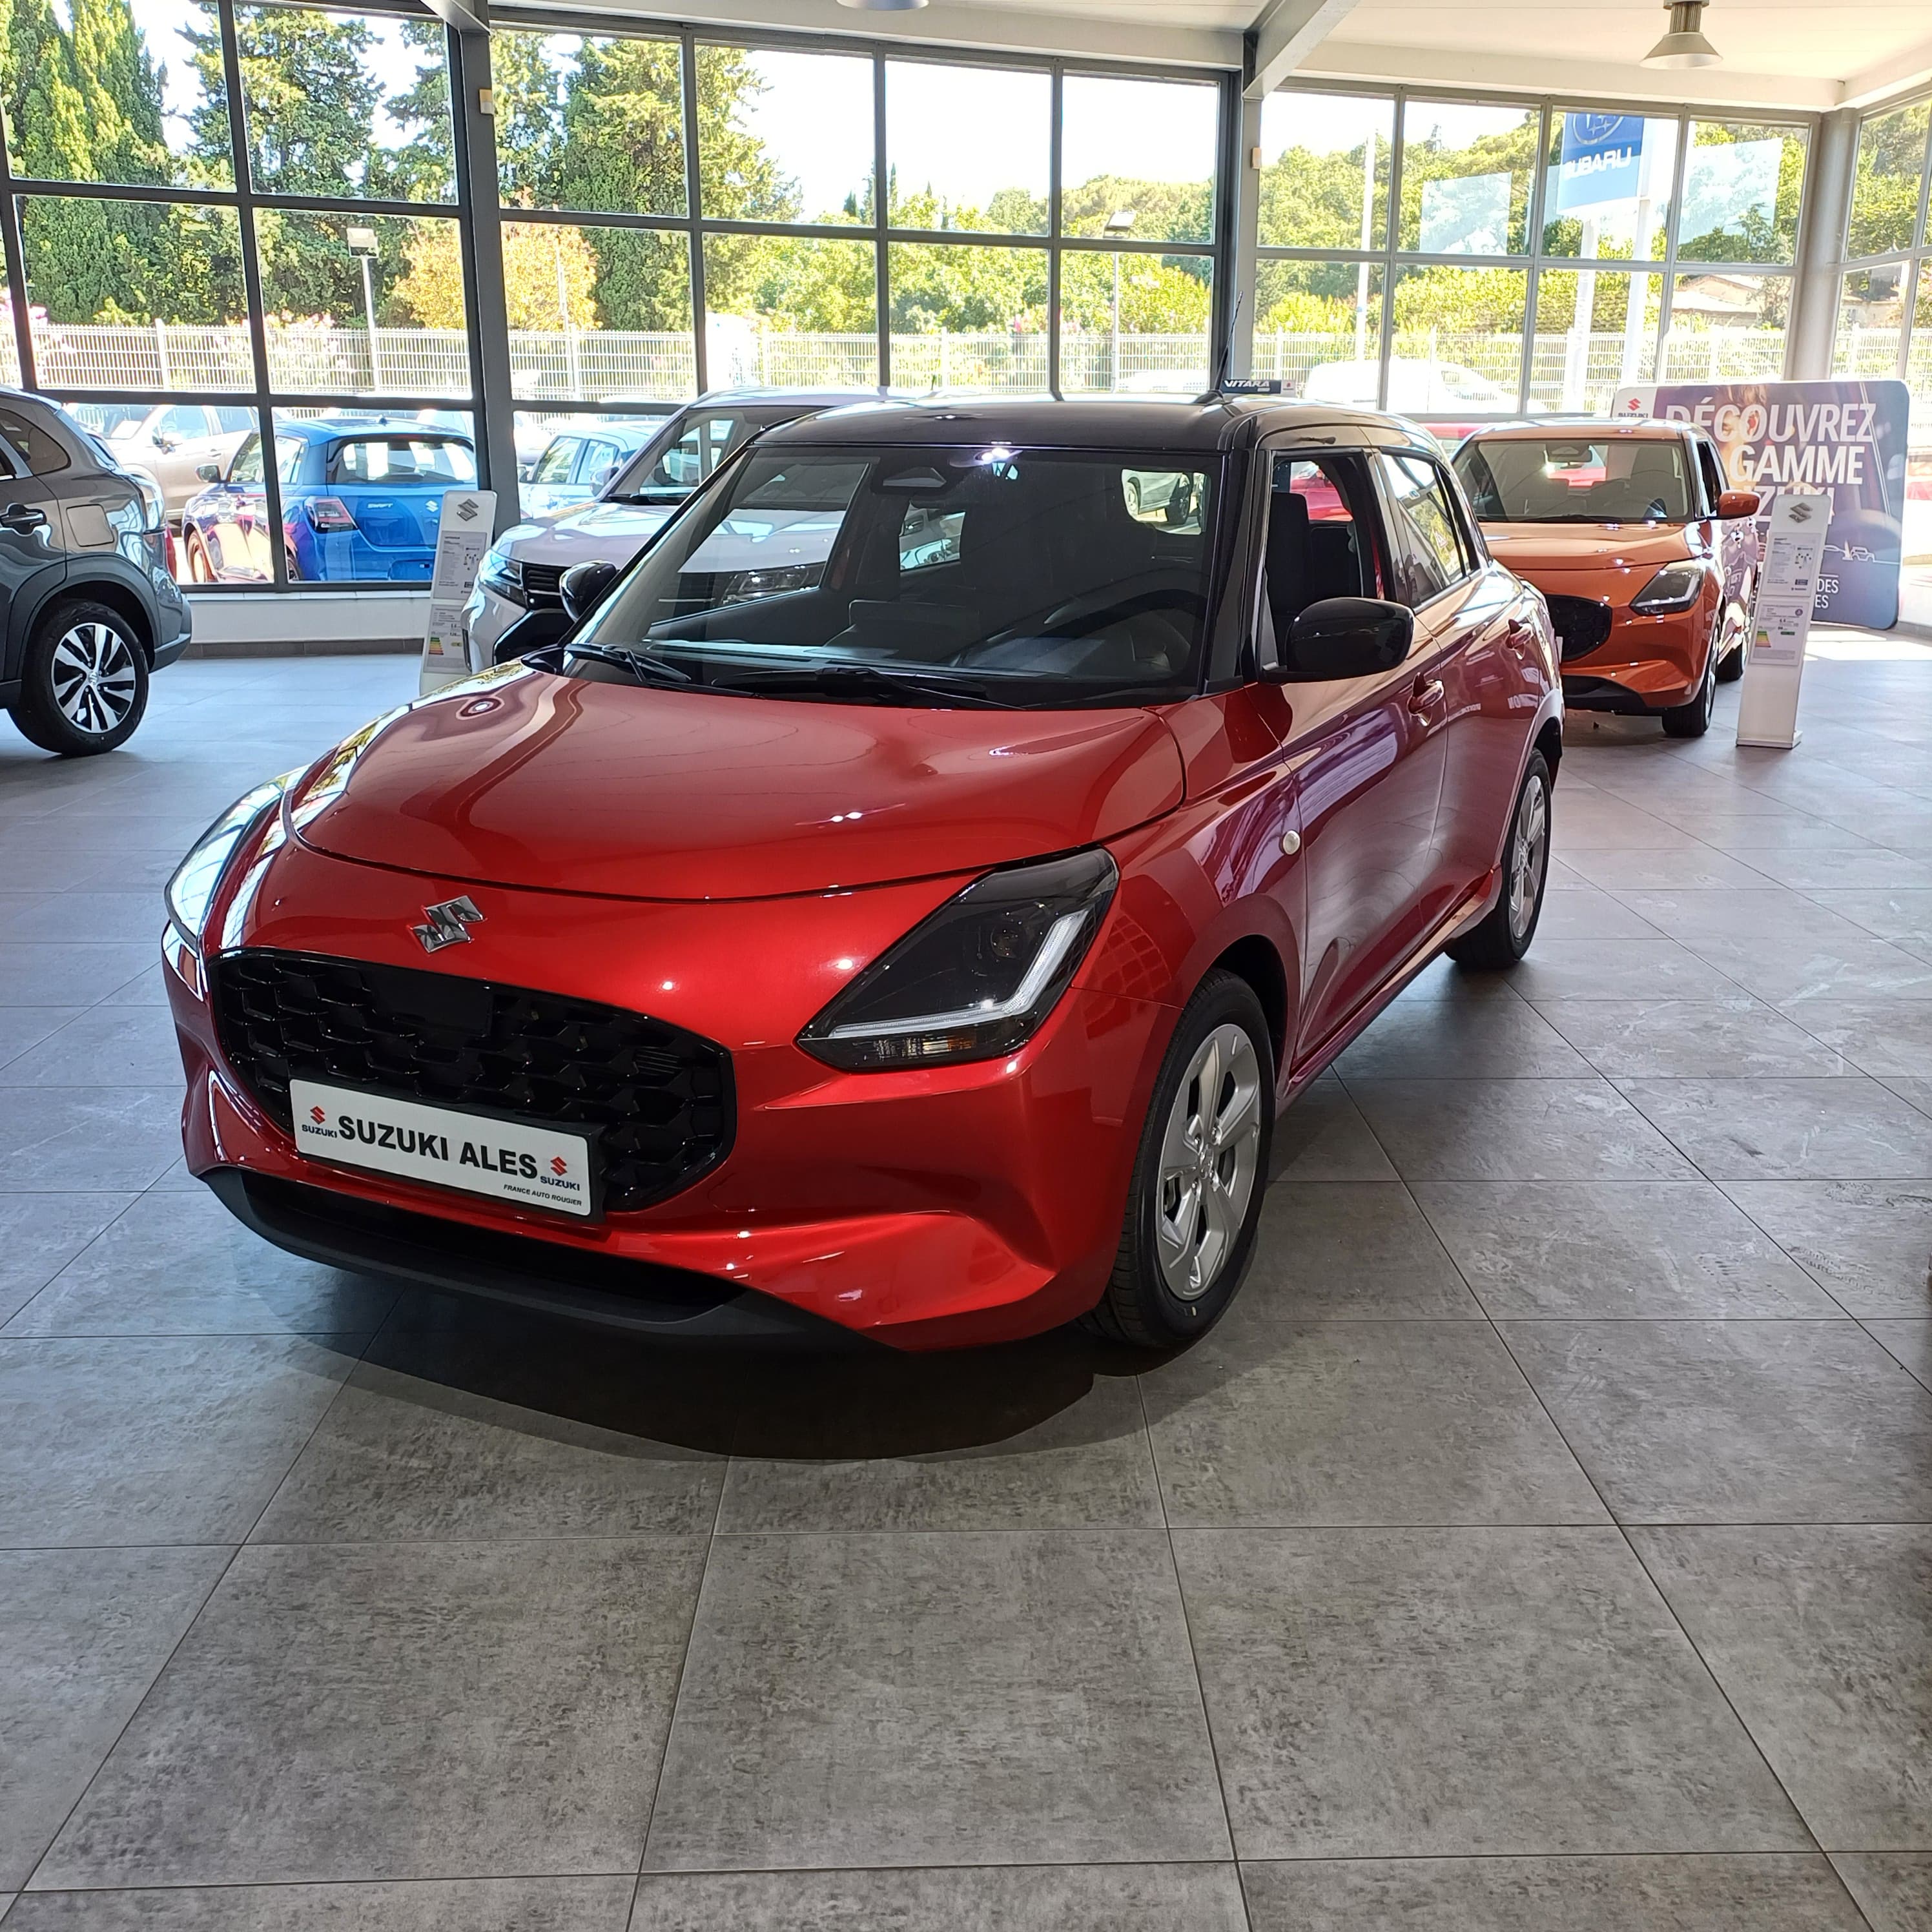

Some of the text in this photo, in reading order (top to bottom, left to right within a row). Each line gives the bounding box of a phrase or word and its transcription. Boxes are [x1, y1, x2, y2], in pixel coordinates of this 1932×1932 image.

[1729, 445, 1865, 484] GAMME
[302, 1124, 337, 1138] SUZUKI
[338, 1116, 538, 1179] SUZUKI ALES
[540, 1176, 581, 1191] SUZUKI
[504, 1184, 582, 1206] FRANCE AUTO ROUGIER
